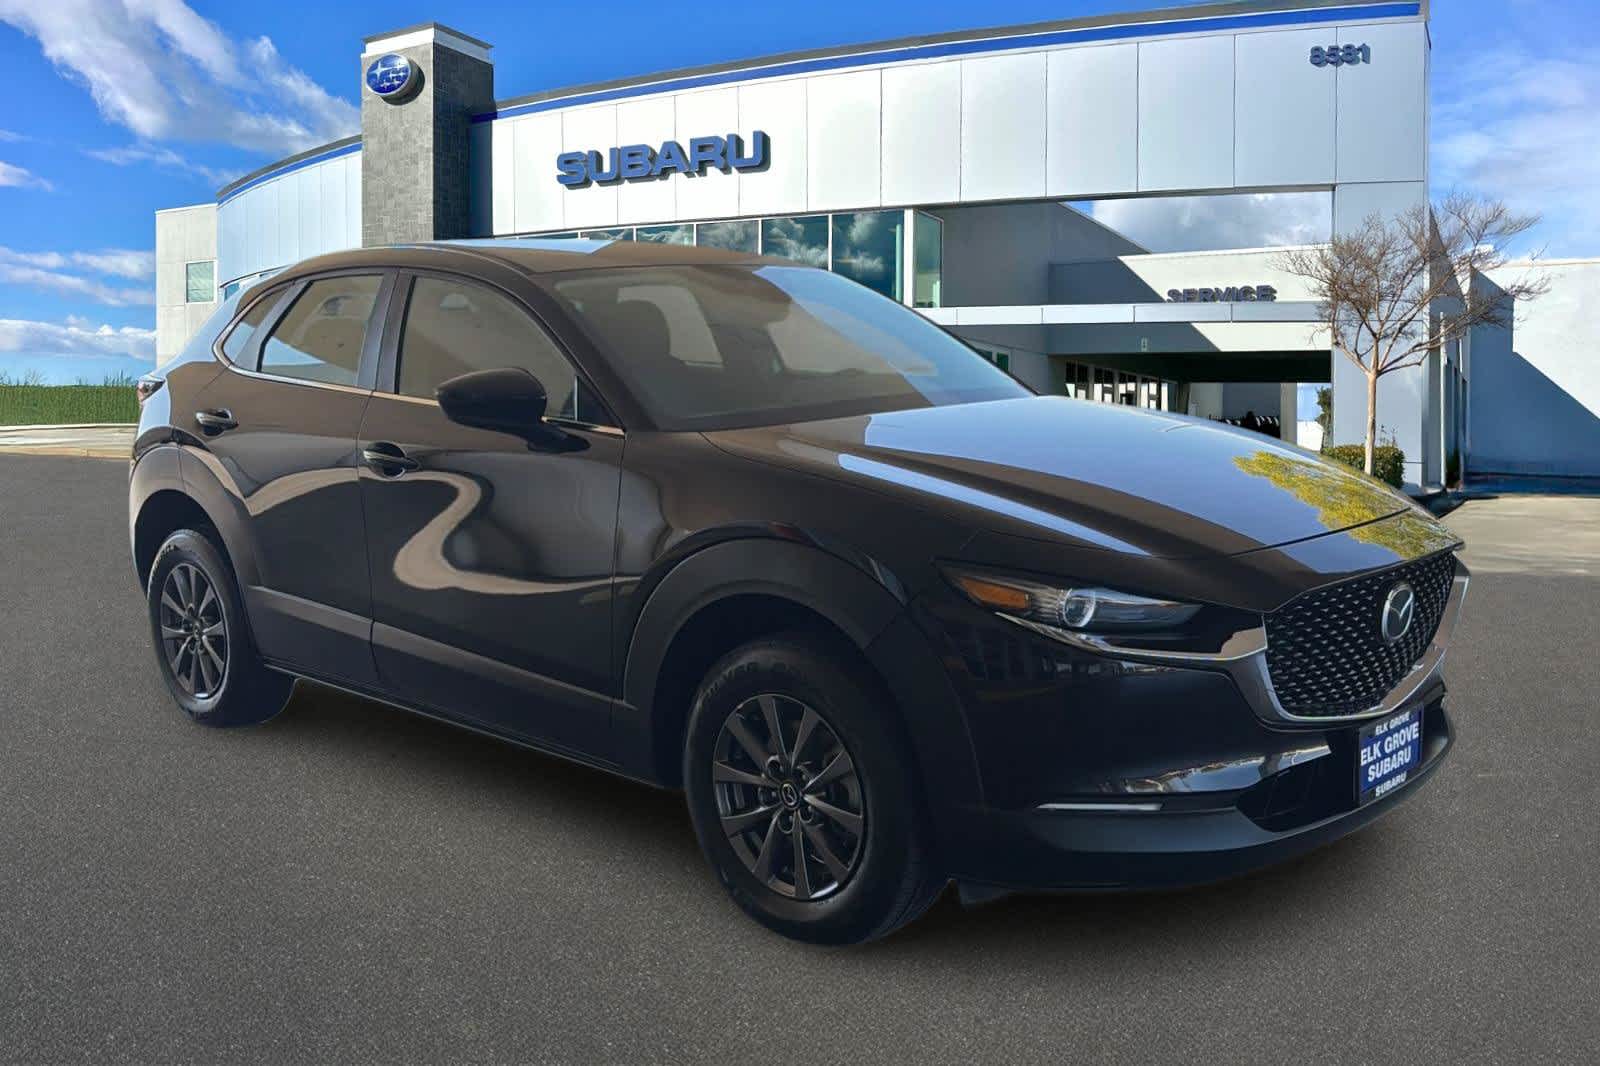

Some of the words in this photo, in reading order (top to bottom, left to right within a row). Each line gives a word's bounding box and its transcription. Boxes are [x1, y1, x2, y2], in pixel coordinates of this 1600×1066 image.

[556, 130, 771, 190] SUBARU
[1166, 284, 1277, 302] SERVICE
[1360, 741, 1382, 767] ELK
[1384, 721, 1420, 753] GROVE
[1375, 722, 1389, 736] ELK
[1367, 745, 1412, 782] SUBARU
[1375, 771, 1407, 797] SUBARU
